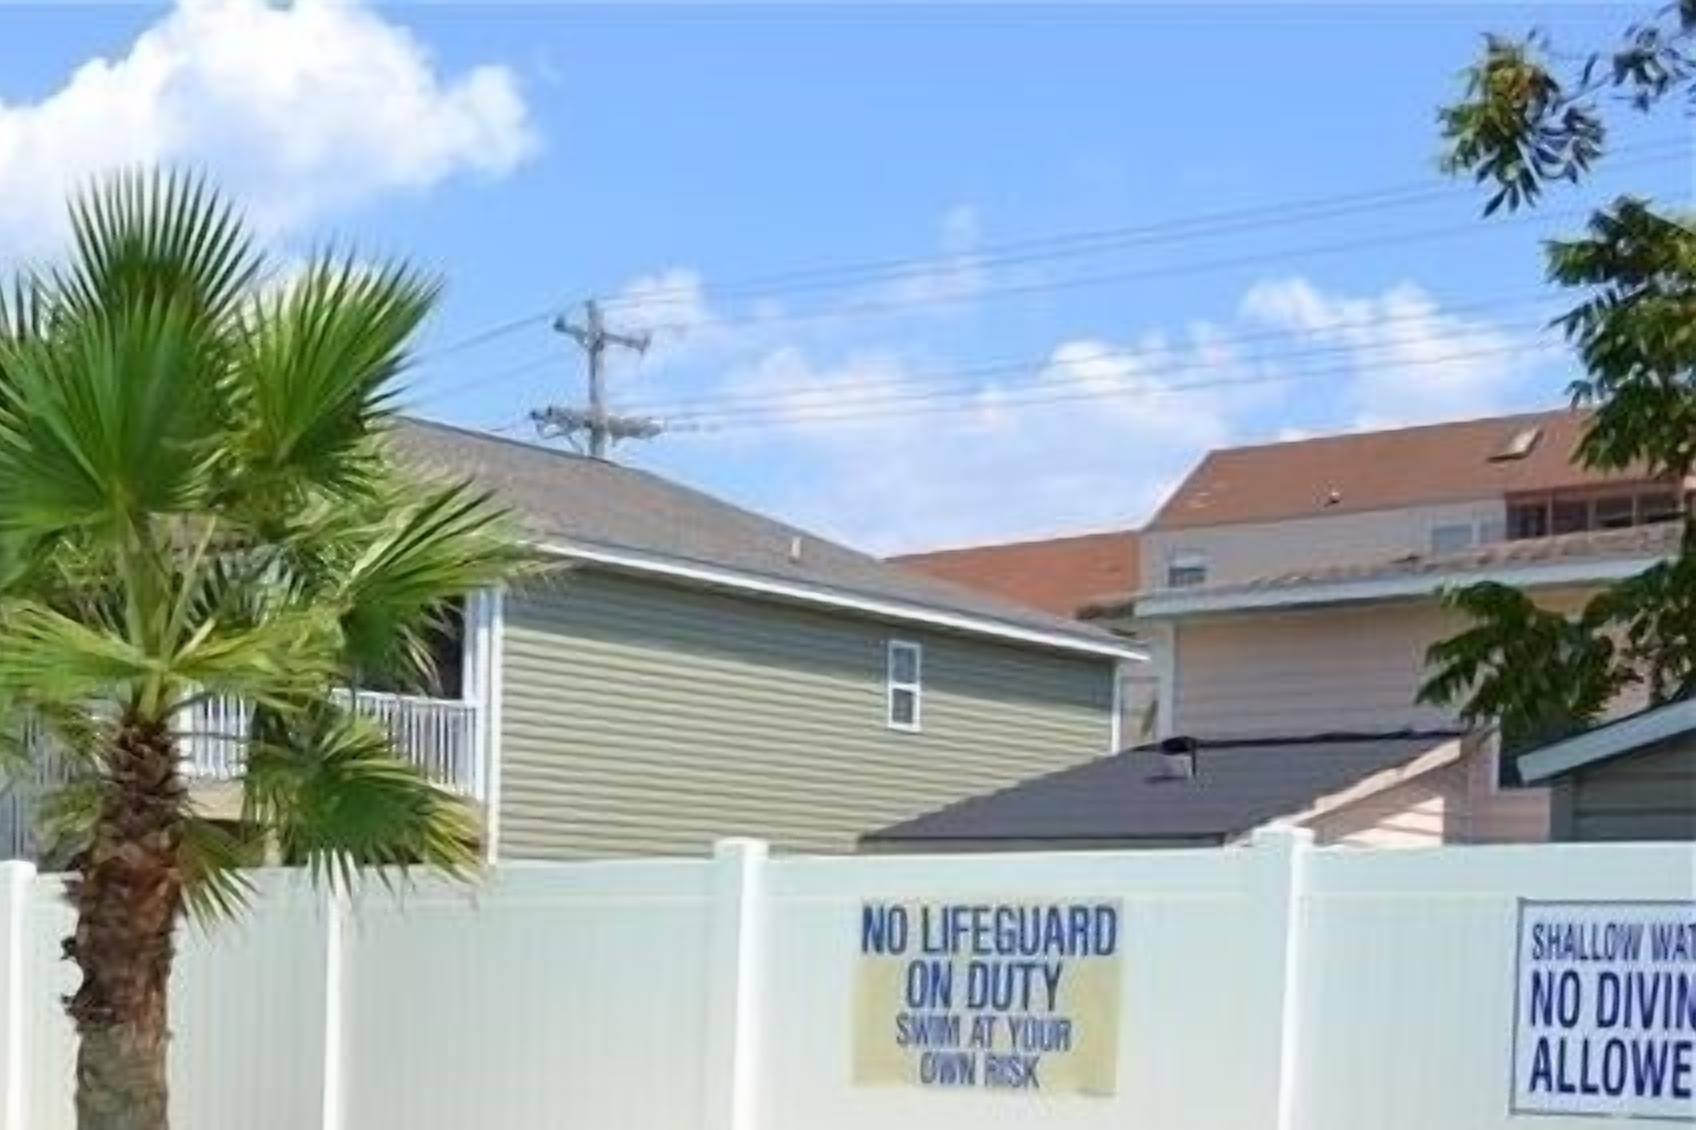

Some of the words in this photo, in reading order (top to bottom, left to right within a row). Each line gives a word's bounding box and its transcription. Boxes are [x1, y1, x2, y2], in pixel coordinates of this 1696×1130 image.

[861, 904, 908, 955] NO
[921, 904, 1117, 956] LIFEGUARD
[1532, 922, 1644, 961] SHALLOW
[907, 959, 952, 1009] ON
[967, 960, 1064, 1012] DUTY
[1531, 969, 1581, 1029] NO
[896, 1012, 960, 1048] SWIM
[971, 1015, 996, 1049] AT
[1008, 1016, 1072, 1051] YOUR
[920, 1051, 975, 1086] OWN
[984, 1054, 1040, 1089] RISK
[1529, 1036, 1692, 1099] ALLOWE
